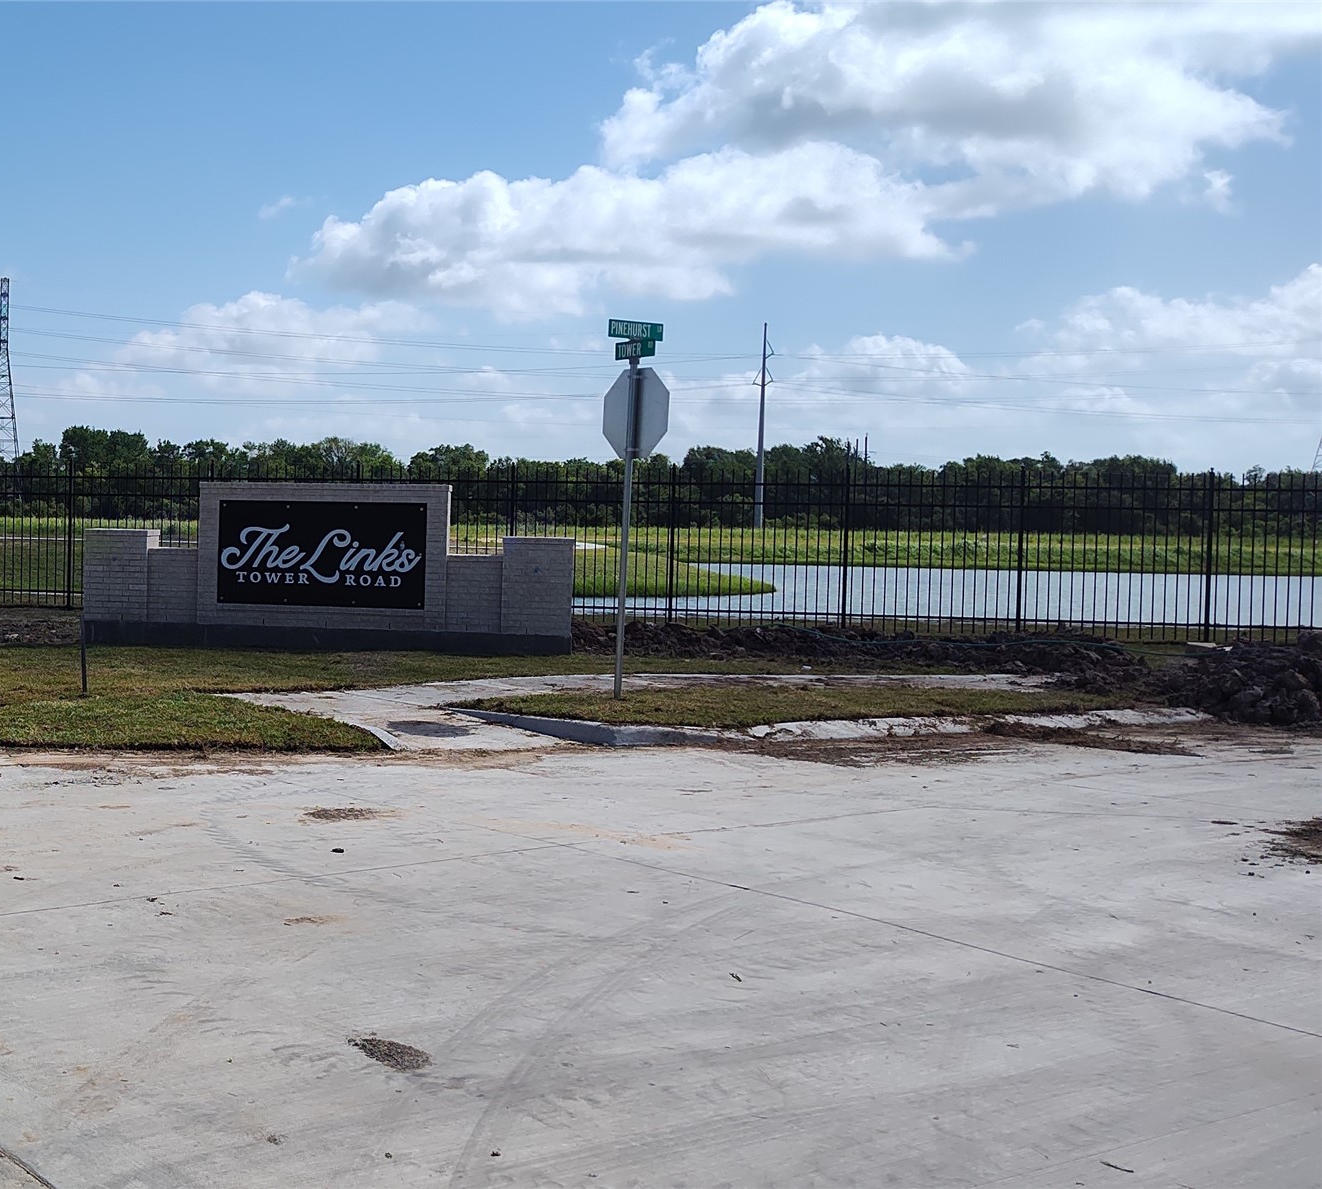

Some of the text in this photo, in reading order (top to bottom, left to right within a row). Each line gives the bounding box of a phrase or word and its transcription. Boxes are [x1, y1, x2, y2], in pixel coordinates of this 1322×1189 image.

[611, 321, 651, 337] PINEHURST
[618, 343, 641, 357] TOWER
[220, 523, 422, 584] The Links
[236, 571, 402, 587] TOWER ROAD
